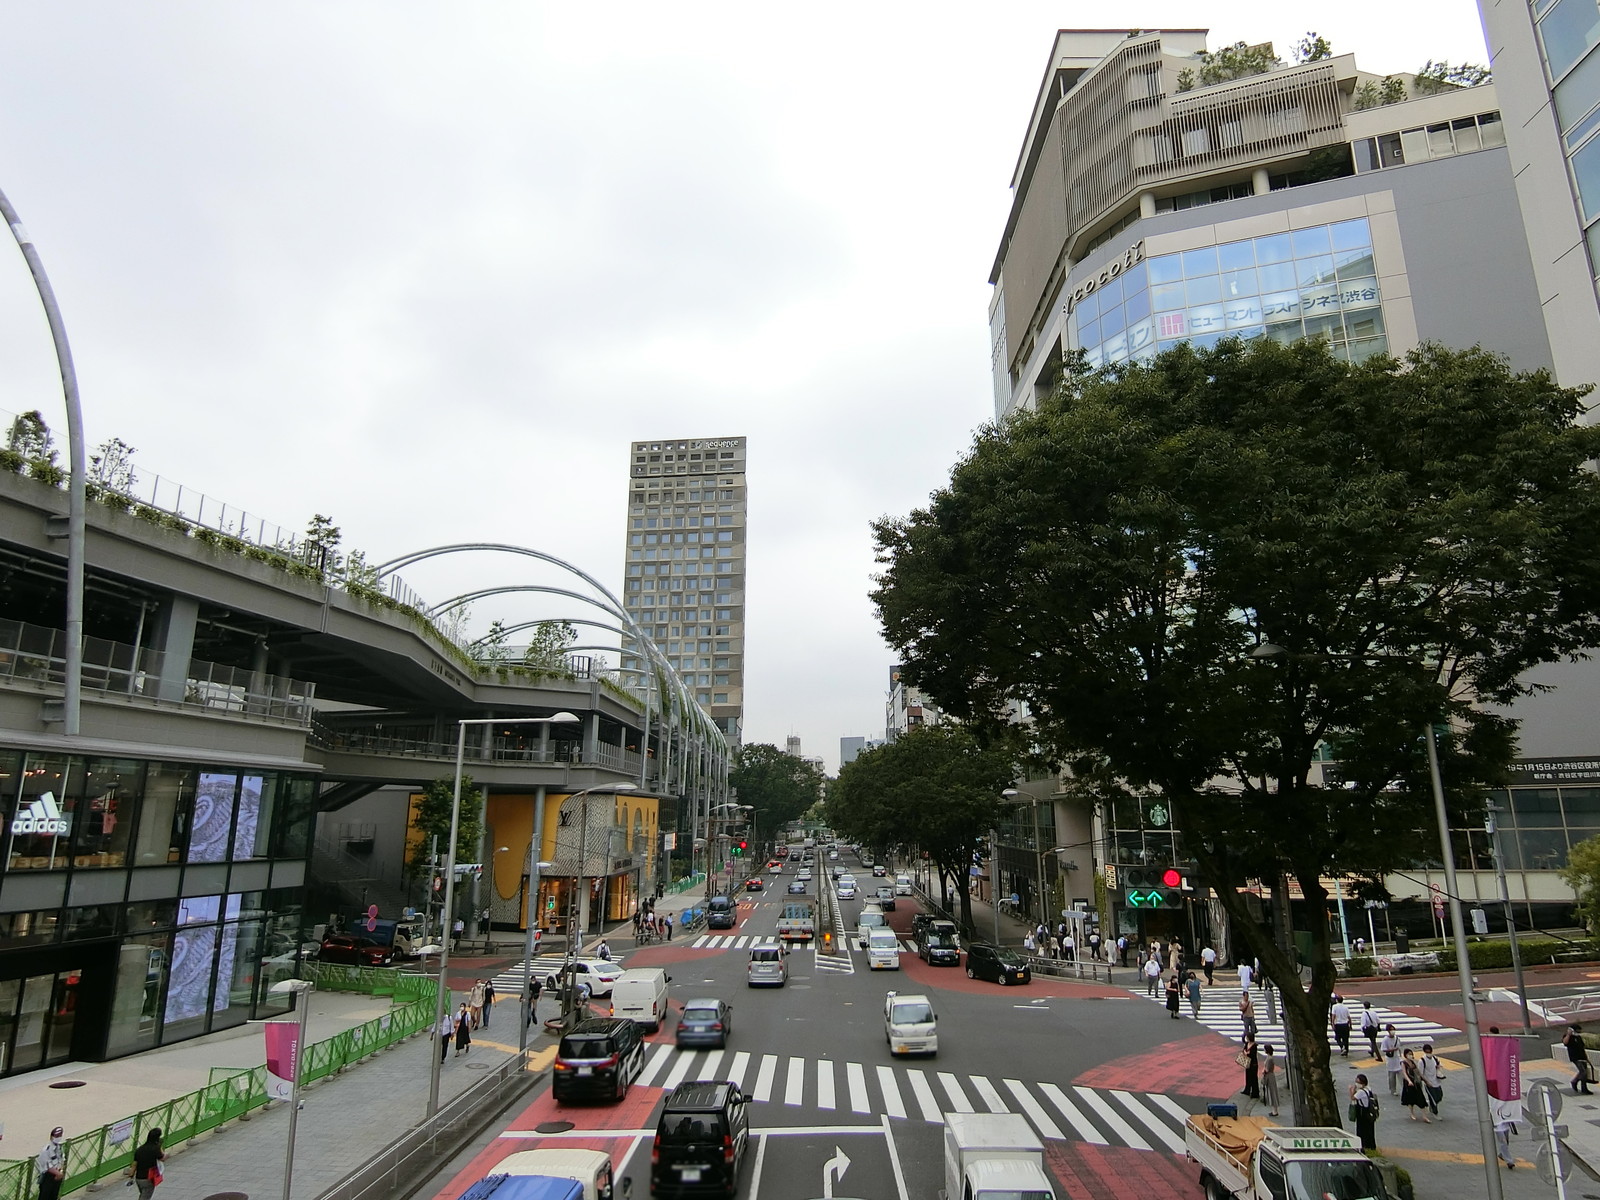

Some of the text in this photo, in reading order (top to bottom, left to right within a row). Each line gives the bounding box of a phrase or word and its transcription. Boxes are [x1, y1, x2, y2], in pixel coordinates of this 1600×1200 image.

[1073, 240, 1143, 301] cocoti
[1190, 288, 1376, 328] ヒューマントラストシネマ渋谷
[705, 440, 739, 449] sequence
[1505, 761, 1600, 771] 19年1月15日より渋谷区役所
[11, 817, 67, 833] adidas
[1294, 1139, 1352, 1148] NIGITA
